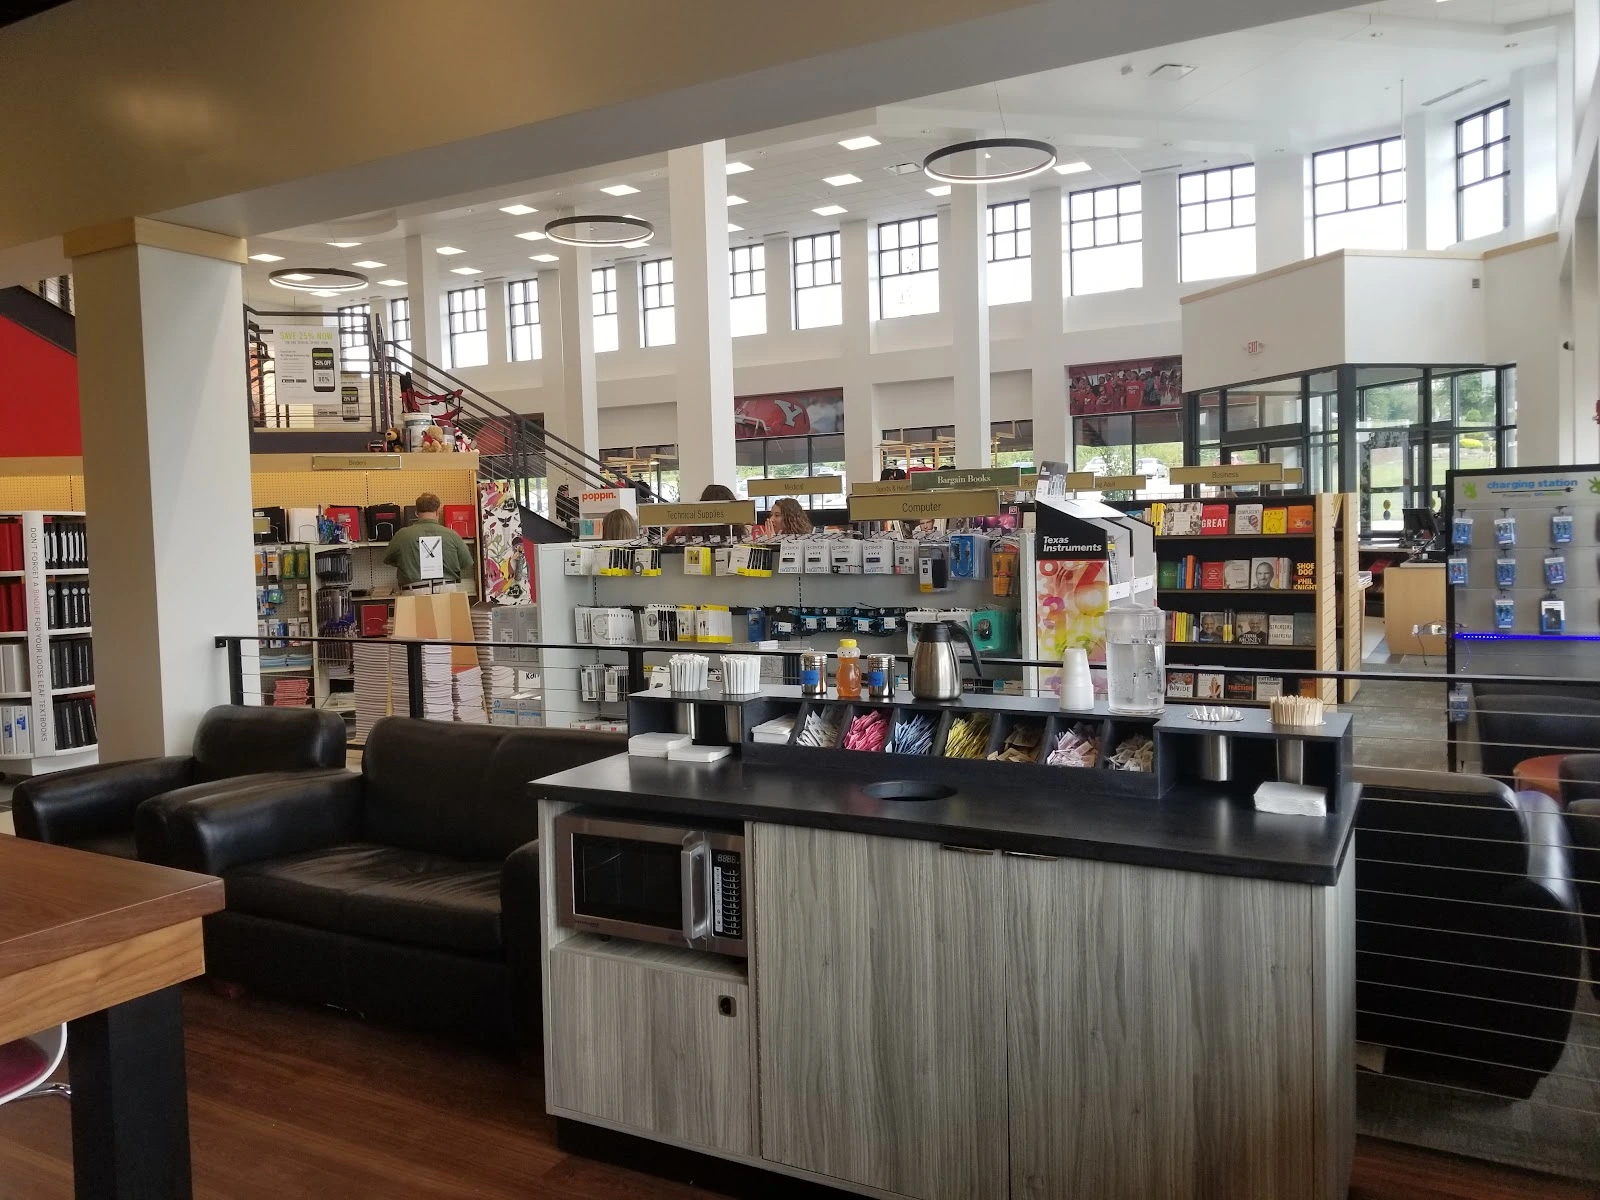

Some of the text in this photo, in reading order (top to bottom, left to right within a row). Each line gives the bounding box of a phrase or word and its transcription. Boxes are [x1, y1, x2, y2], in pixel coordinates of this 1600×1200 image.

[280, 331, 333, 340] SAVE 25% NOW
[937, 474, 991, 486] Bargain Books
[1211, 471, 1239, 479] Business
[784, 483, 804, 491] Medical
[875, 485, 892, 493] Sports
[1487, 478, 1578, 489] charging station
[581, 491, 617, 502] poppin.
[902, 502, 942, 513] Computer
[667, 509, 725, 520] Technical Supplies
[1201, 518, 1227, 528] GREAT
[30, 527, 38, 550] DON'T
[1043, 536, 1069, 544] Texas
[1043, 543, 1102, 552] Instruments
[31, 551, 39, 578] FORGET
[1296, 562, 1315, 570] SHOE
[1298, 568, 1313, 576] DOG
[33, 589, 41, 615] BINDER
[34, 617, 42, 632] FOR
[35, 633, 43, 653] YOUR
[36, 655, 44, 679] LOOSE
[37, 680, 45, 697] LEAF
[38, 699, 48, 742] TEXTBOOKS
